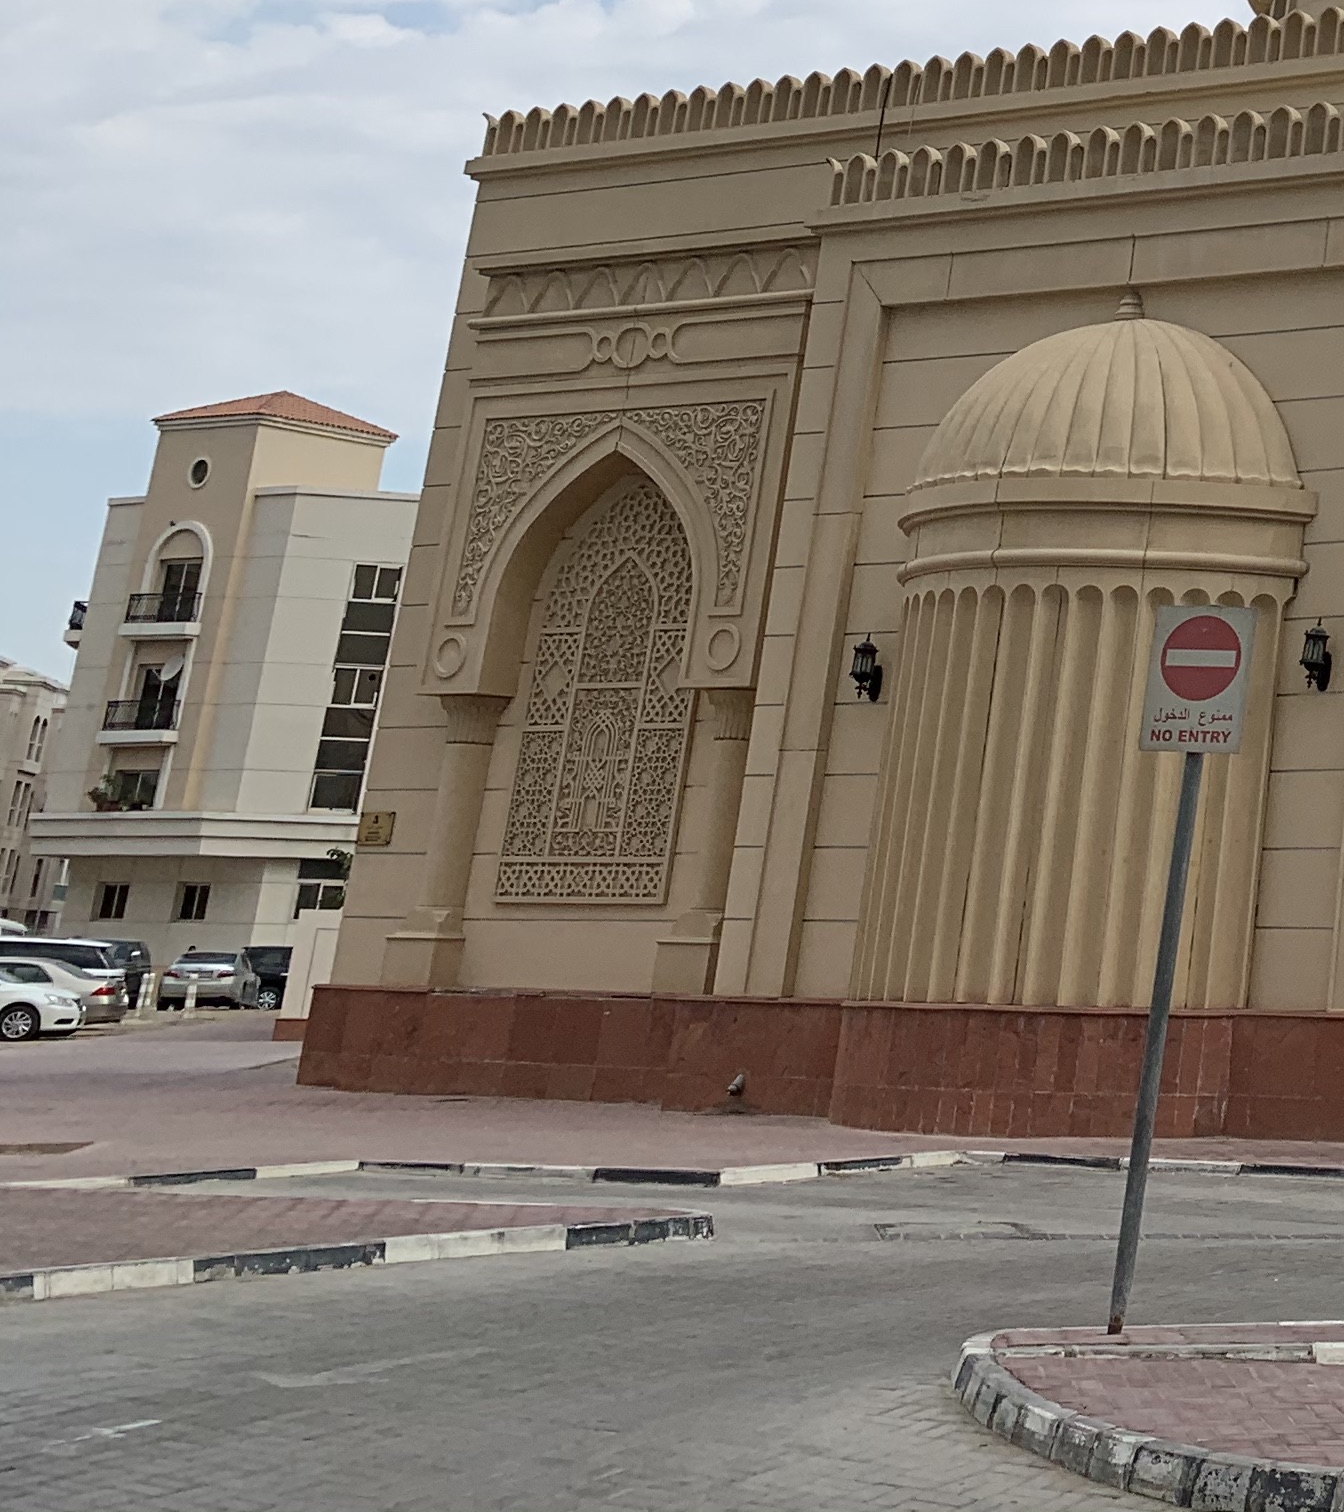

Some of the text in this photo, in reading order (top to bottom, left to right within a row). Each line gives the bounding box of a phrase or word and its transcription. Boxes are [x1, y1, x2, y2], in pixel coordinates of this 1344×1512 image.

[1153, 707, 1233, 727] ممنوع الدخول
[1150, 729, 1232, 744] NO ENTRY
